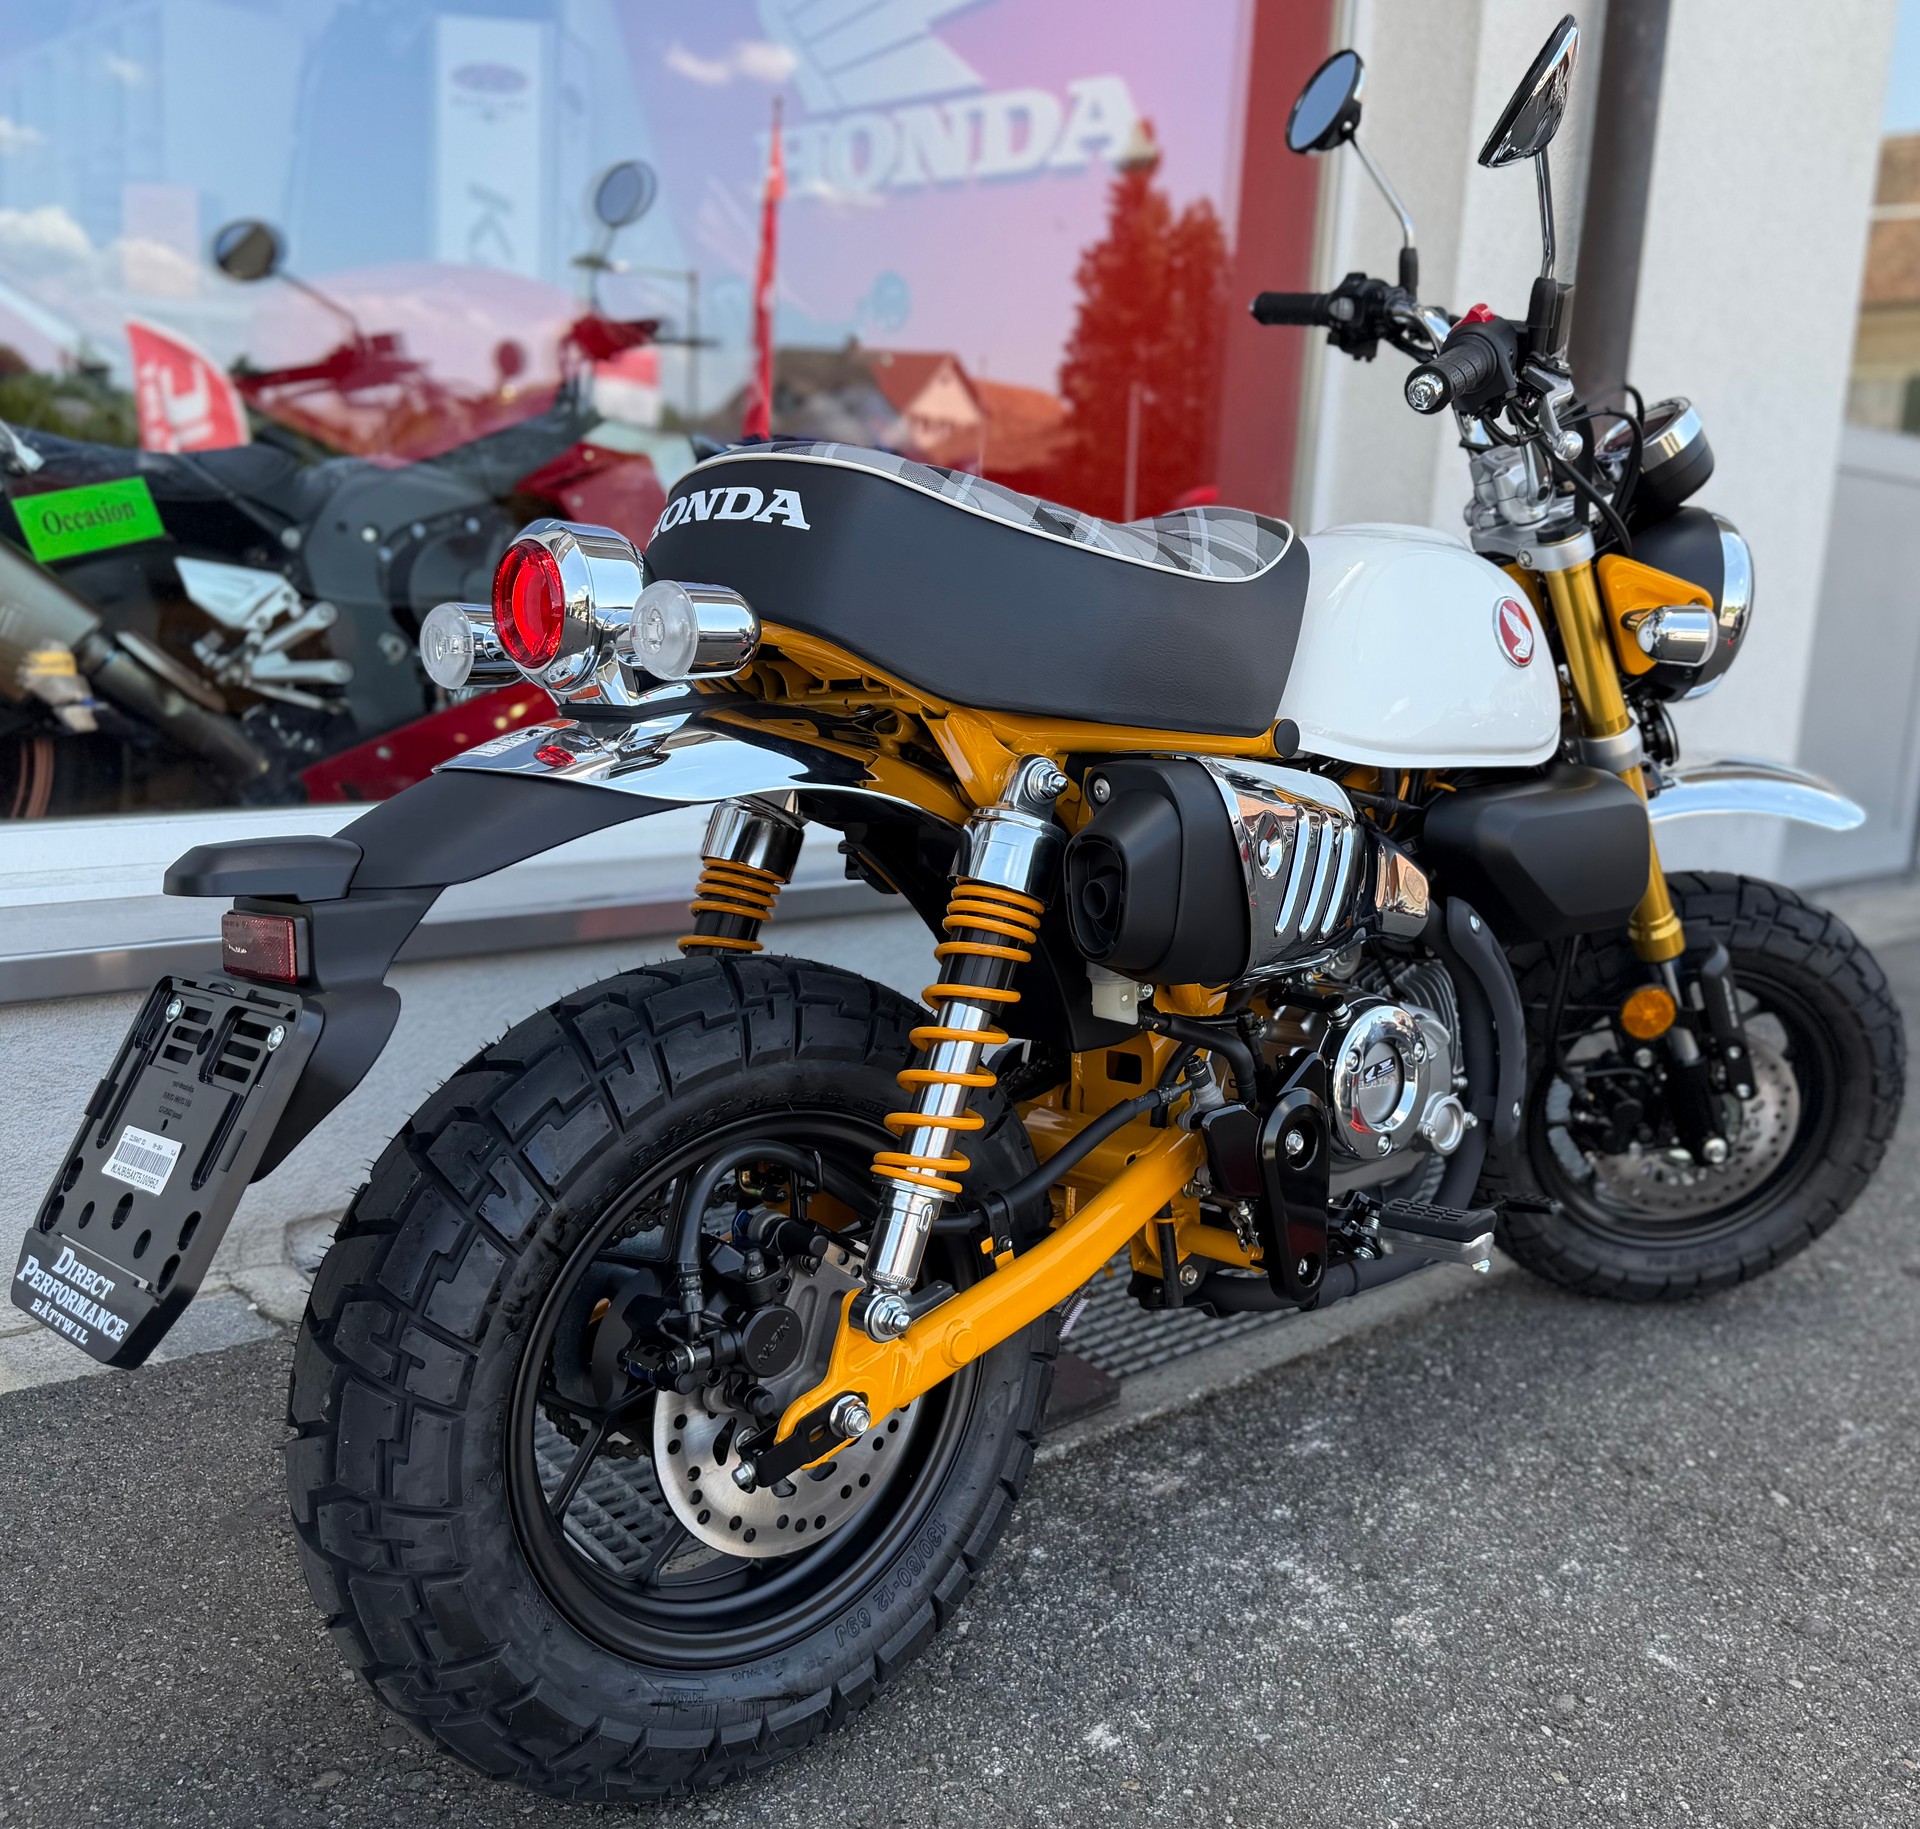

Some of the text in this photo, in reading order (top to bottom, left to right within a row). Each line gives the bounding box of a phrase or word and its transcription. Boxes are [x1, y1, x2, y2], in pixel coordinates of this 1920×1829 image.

[754, 74, 1137, 198] HONDA
[41, 499, 137, 536] Occasion
[16, 1254, 130, 1342] PERFORMANCE
[51, 1245, 116, 1301] DIRECT
[30, 1297, 89, 1345] BÄTTWIL
[834, 1518, 948, 1648] 130/80-12 69J
